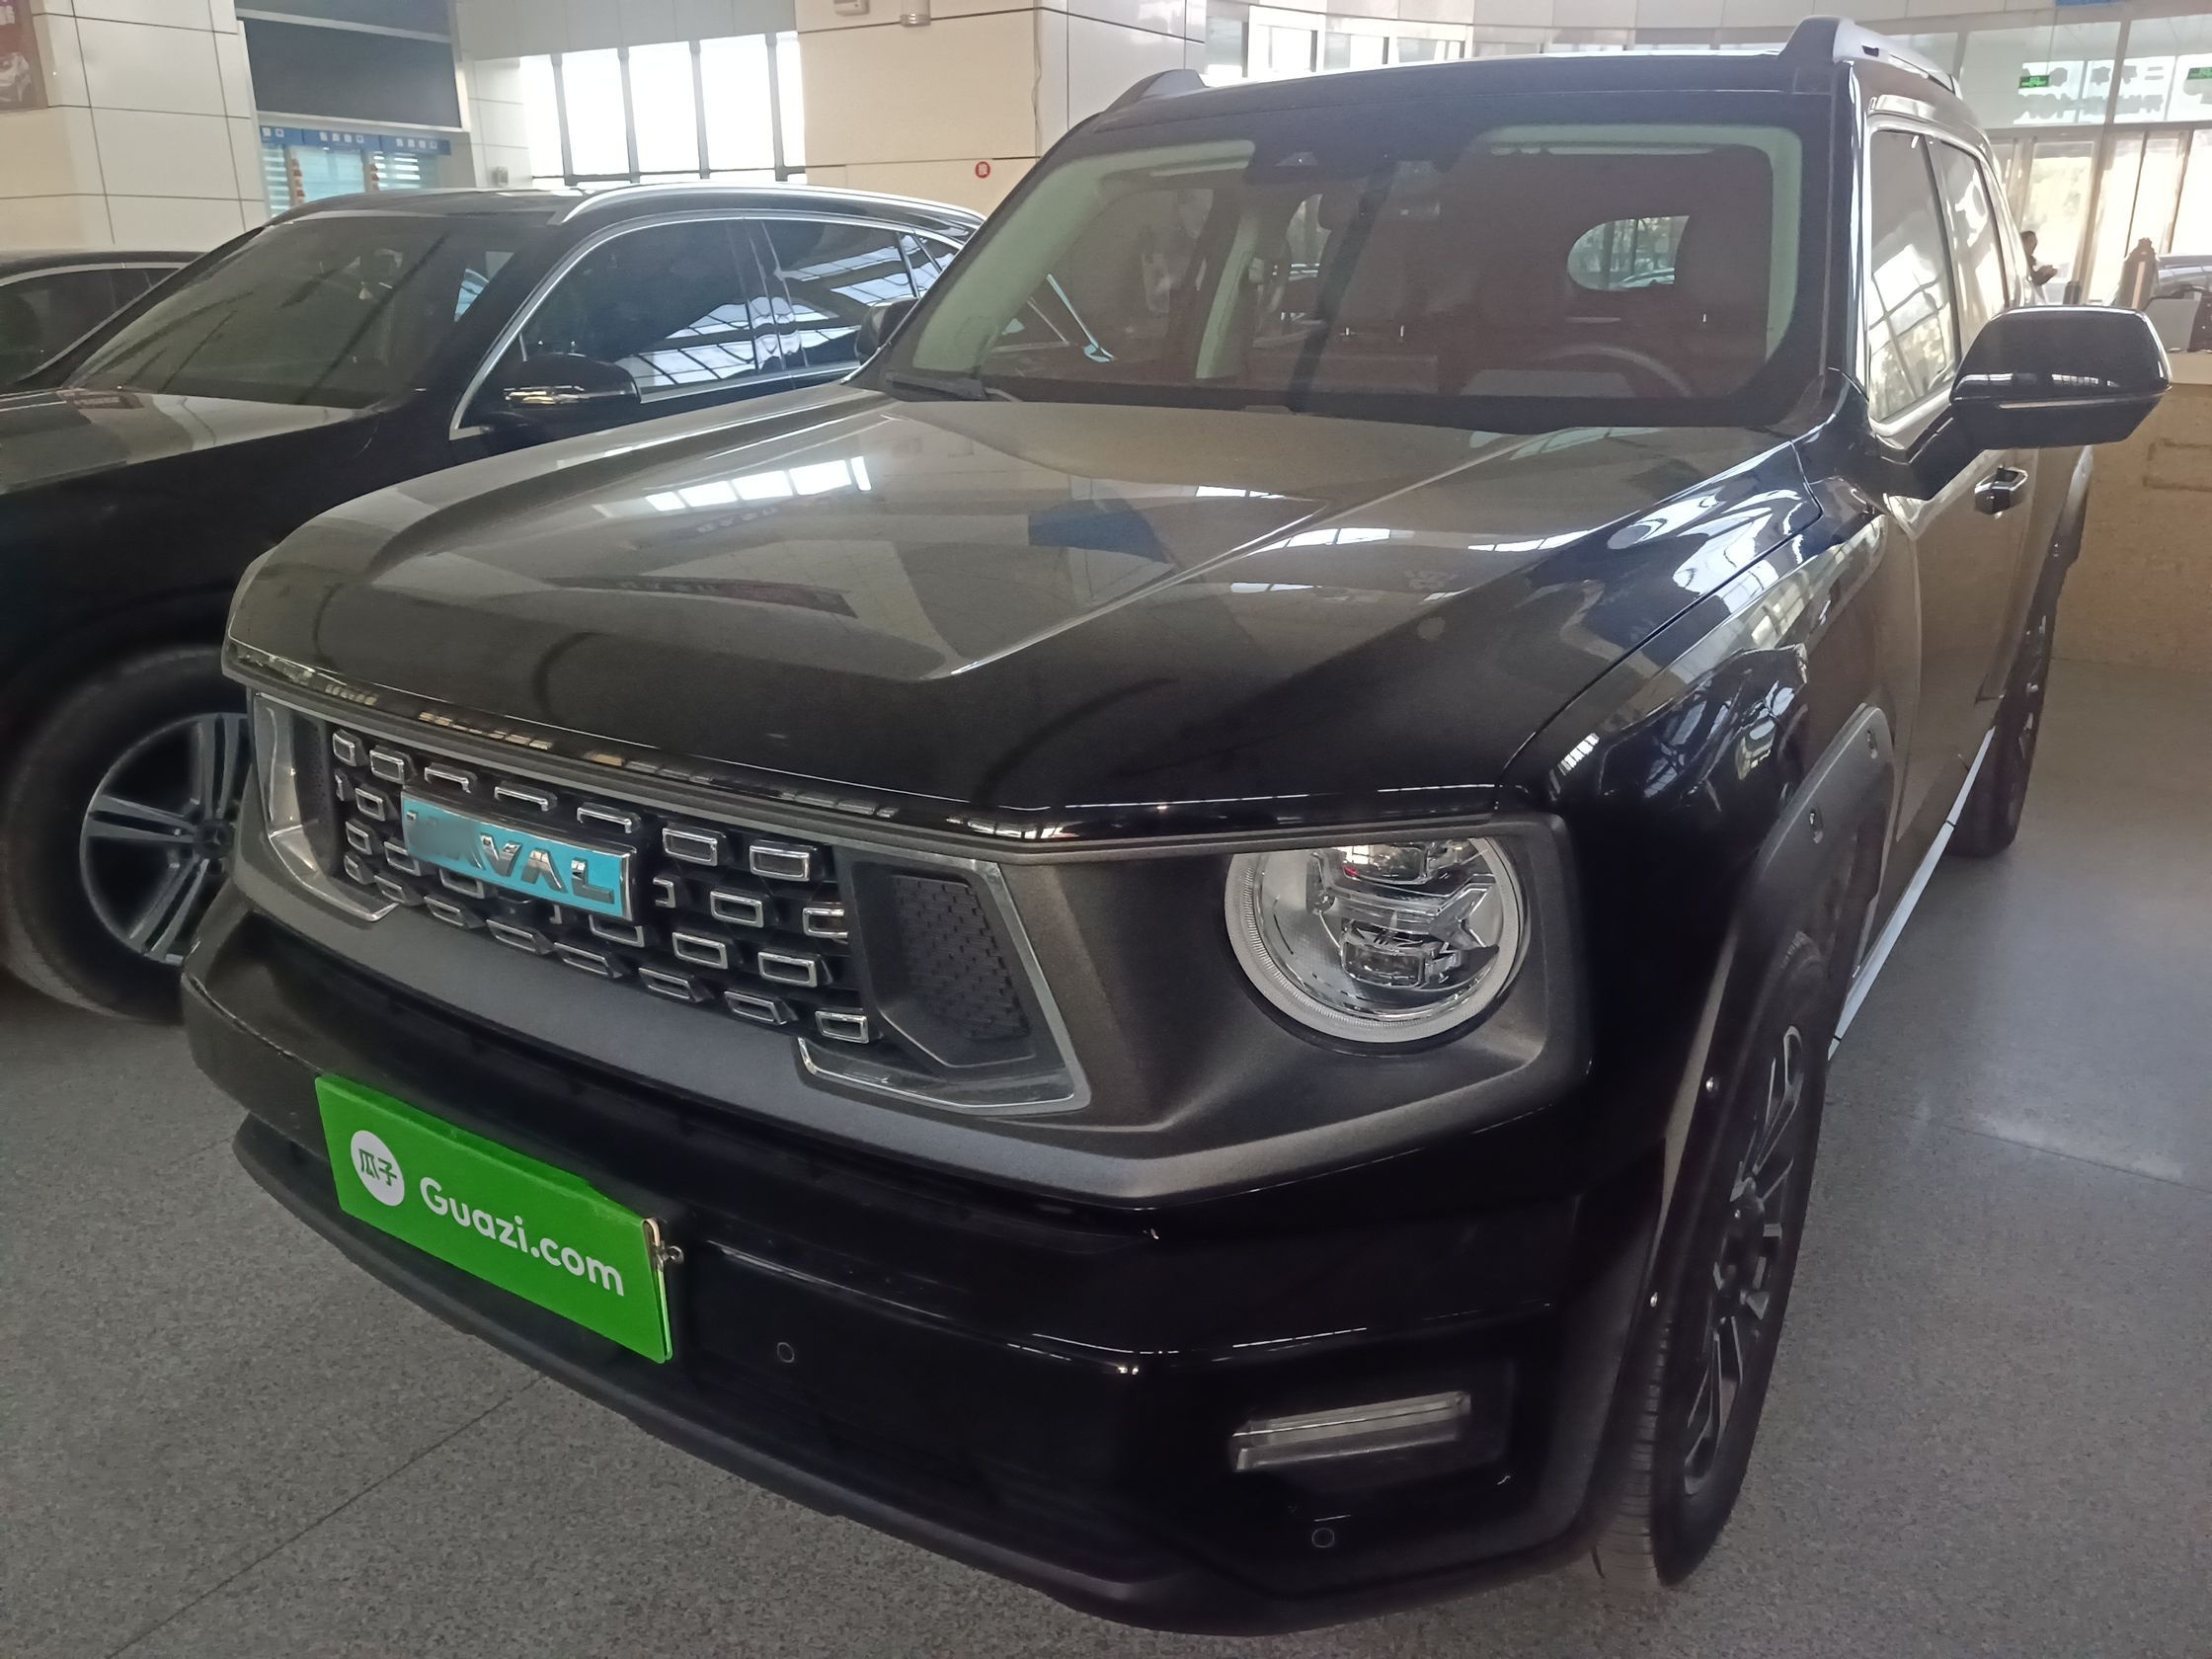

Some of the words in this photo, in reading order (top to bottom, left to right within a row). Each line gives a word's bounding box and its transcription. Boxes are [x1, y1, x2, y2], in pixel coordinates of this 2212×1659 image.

[406, 810, 615, 905] VAL
[358, 1148, 397, 1186] 瓜子
[420, 1177, 624, 1297] Guazi.com
